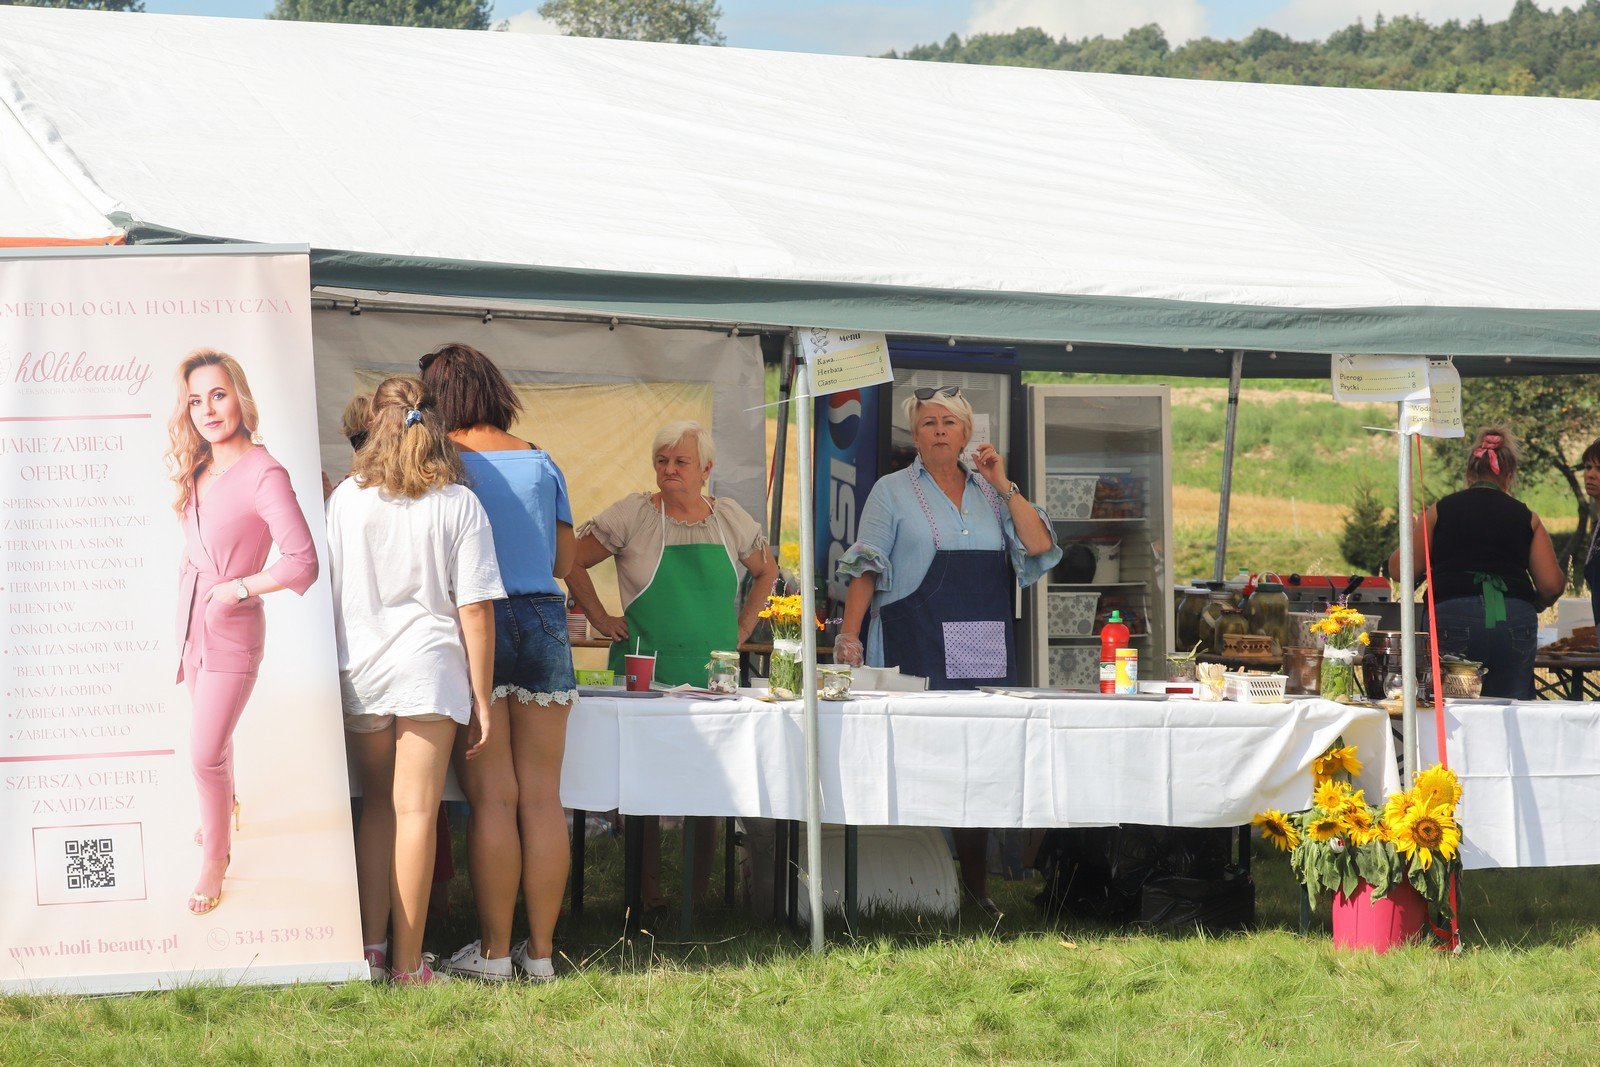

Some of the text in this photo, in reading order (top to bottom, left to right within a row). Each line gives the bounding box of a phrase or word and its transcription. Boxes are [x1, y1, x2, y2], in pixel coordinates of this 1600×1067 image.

[0, 297, 294, 318] METOLOGIA HOLISTYCZNA
[15, 350, 154, 396] hOlibeauty
[817, 366, 843, 376] Herbata
[1407, 370, 1416, 378] 12
[817, 379, 838, 388] Ciasto
[0, 435, 126, 455] JAKIE ZABIEGI
[20, 463, 109, 483] OFERUJĘ?
[3, 495, 137, 509] SPERSONALIZOWANE
[4, 515, 151, 530] ZABIEGI KOSMETYCZNE
[6, 535, 125, 551] TERAPIA DLA SKÓR
[7, 557, 144, 572] PROBLEMATYCZNYCH
[8, 577, 127, 593] TERAPIA DLA SKÓR
[9, 600, 74, 614] KLIENTÓW
[10, 620, 135, 635] ONKOLOGICZNYCH
[12, 643, 66, 657] ANALIZA
[112, 639, 149, 652] WRAZ
[152, 639, 160, 651] Z
[14, 684, 113, 698] MASAŻ KOBIDO
[15, 702, 166, 720] ZABIEGI APARATUROWE
[17, 728, 66, 741] ZABIEGI
[68, 727, 88, 739] NA
[6, 769, 159, 790] SZERSZĄ OFERTĘ
[32, 795, 136, 814] ZNAJDZIESZ
[234, 925, 334, 945] 534 539 839
